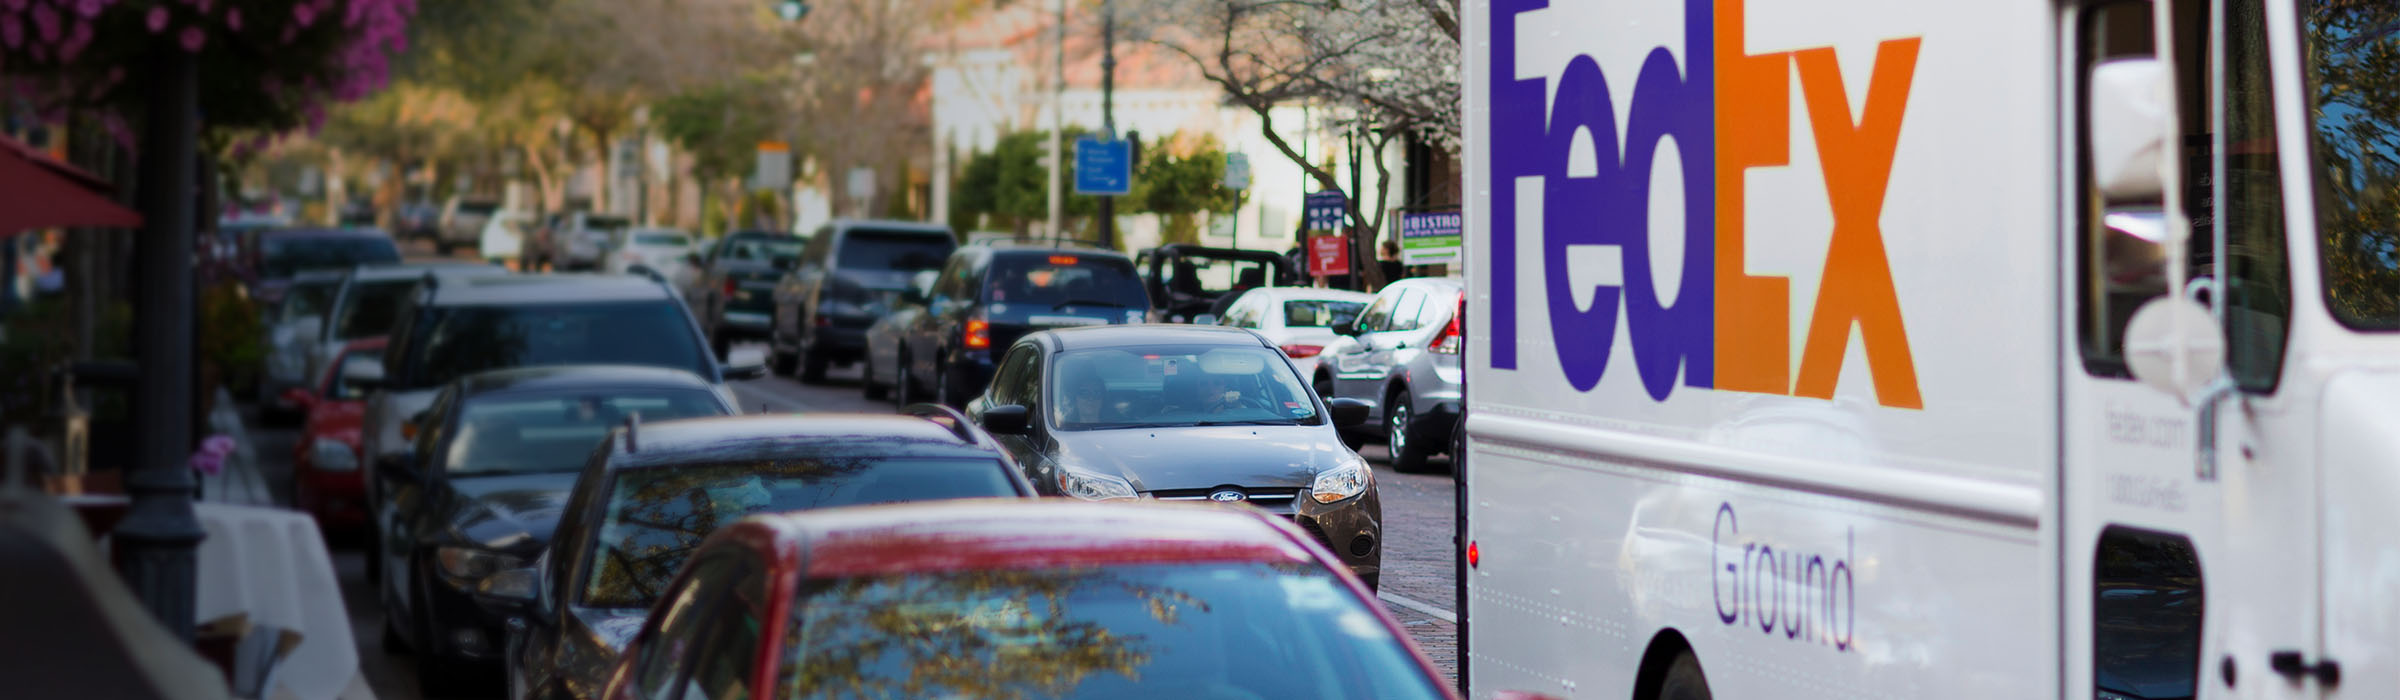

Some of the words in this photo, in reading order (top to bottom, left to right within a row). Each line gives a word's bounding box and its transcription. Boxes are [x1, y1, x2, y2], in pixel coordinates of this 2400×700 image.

[1410, 215, 1460, 229] BISTRO
[1490, 0, 1924, 411] FedEx
[1712, 501, 1855, 652] Ground
